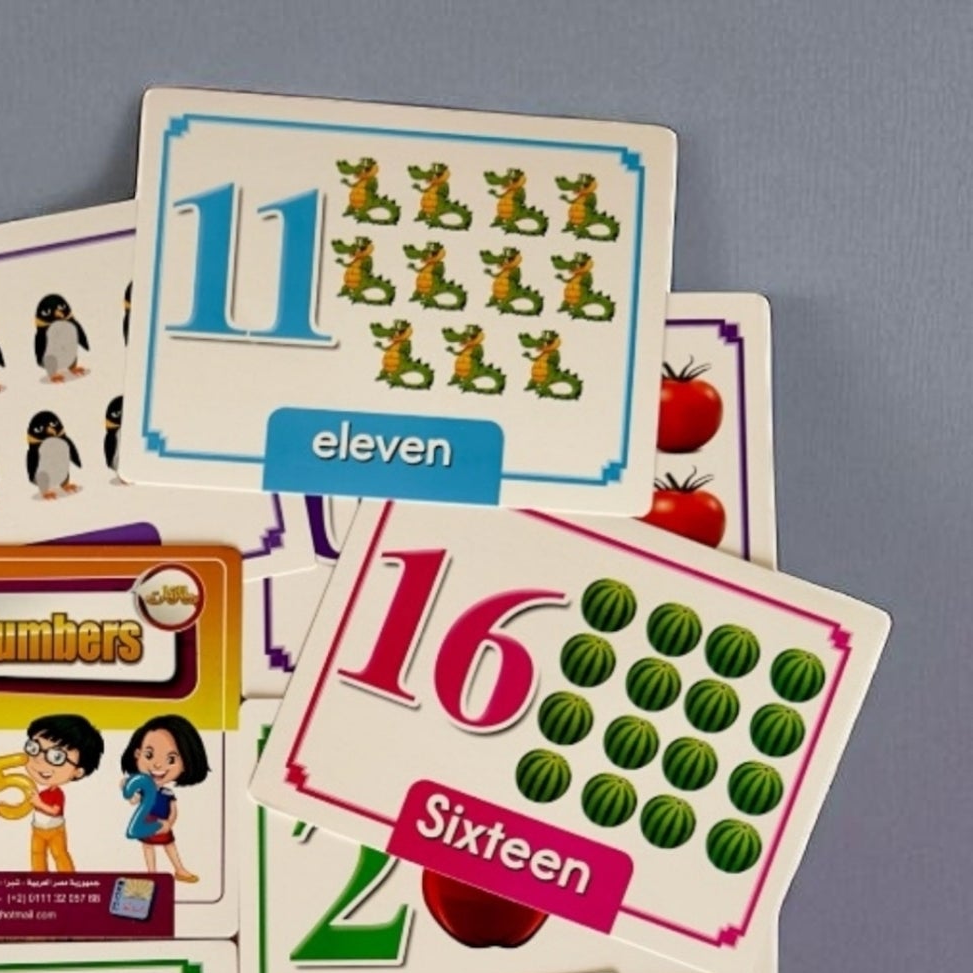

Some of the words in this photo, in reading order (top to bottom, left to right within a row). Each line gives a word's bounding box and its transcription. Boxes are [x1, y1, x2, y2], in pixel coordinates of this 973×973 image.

[165, 183, 339, 349] 11
[312, 421, 453, 467] eleven
[338, 549, 570, 736] 16
[416, 793, 591, 895] Sixteen
